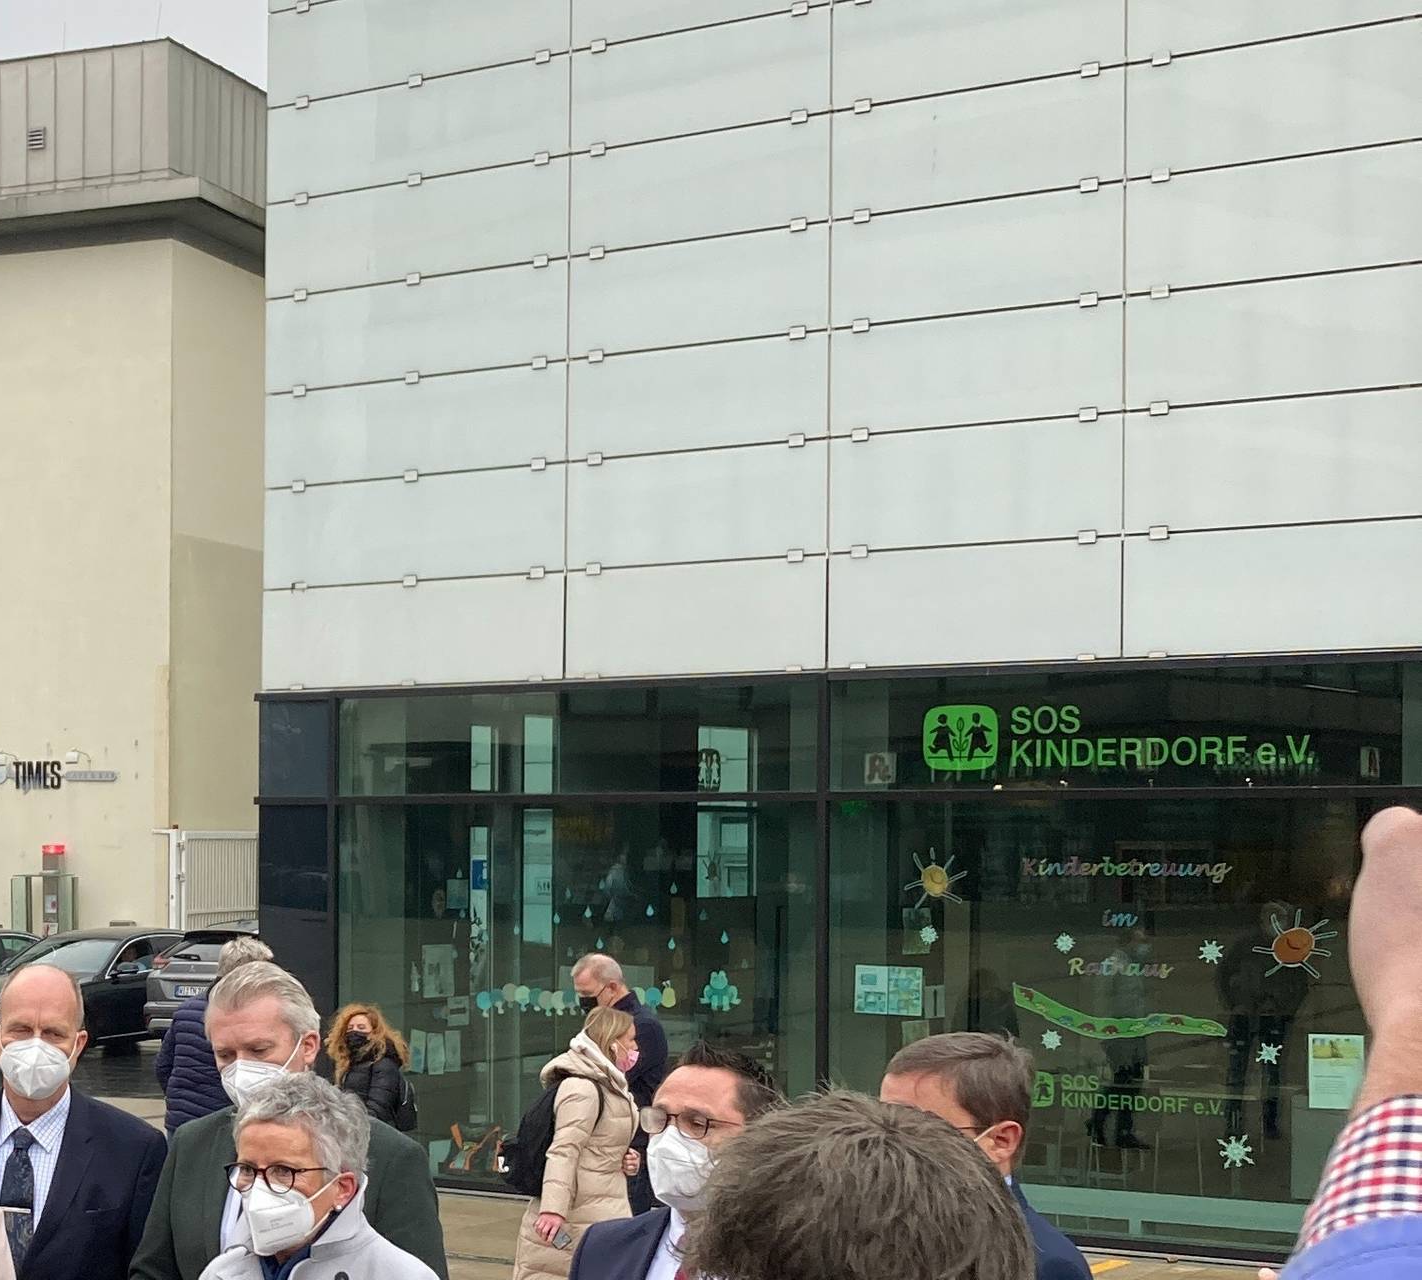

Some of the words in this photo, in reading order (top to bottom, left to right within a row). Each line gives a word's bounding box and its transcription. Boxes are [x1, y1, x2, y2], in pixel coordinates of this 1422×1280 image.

[1010, 705, 1081, 735] SOS
[1011, 735, 1247, 768] KINDERDORF
[1257, 734, 1313, 765] e.V.
[13, 760, 61, 790] TIMES
[1022, 856, 1233, 884] Kinderbetreuung
[1101, 908, 1139, 928] im
[1067, 957, 1175, 979] Rathaus
[1060, 1074, 1099, 1091] SOS
[1061, 1092, 1189, 1114] KINDERDORF
[1193, 1100, 1226, 1116] e.V.
